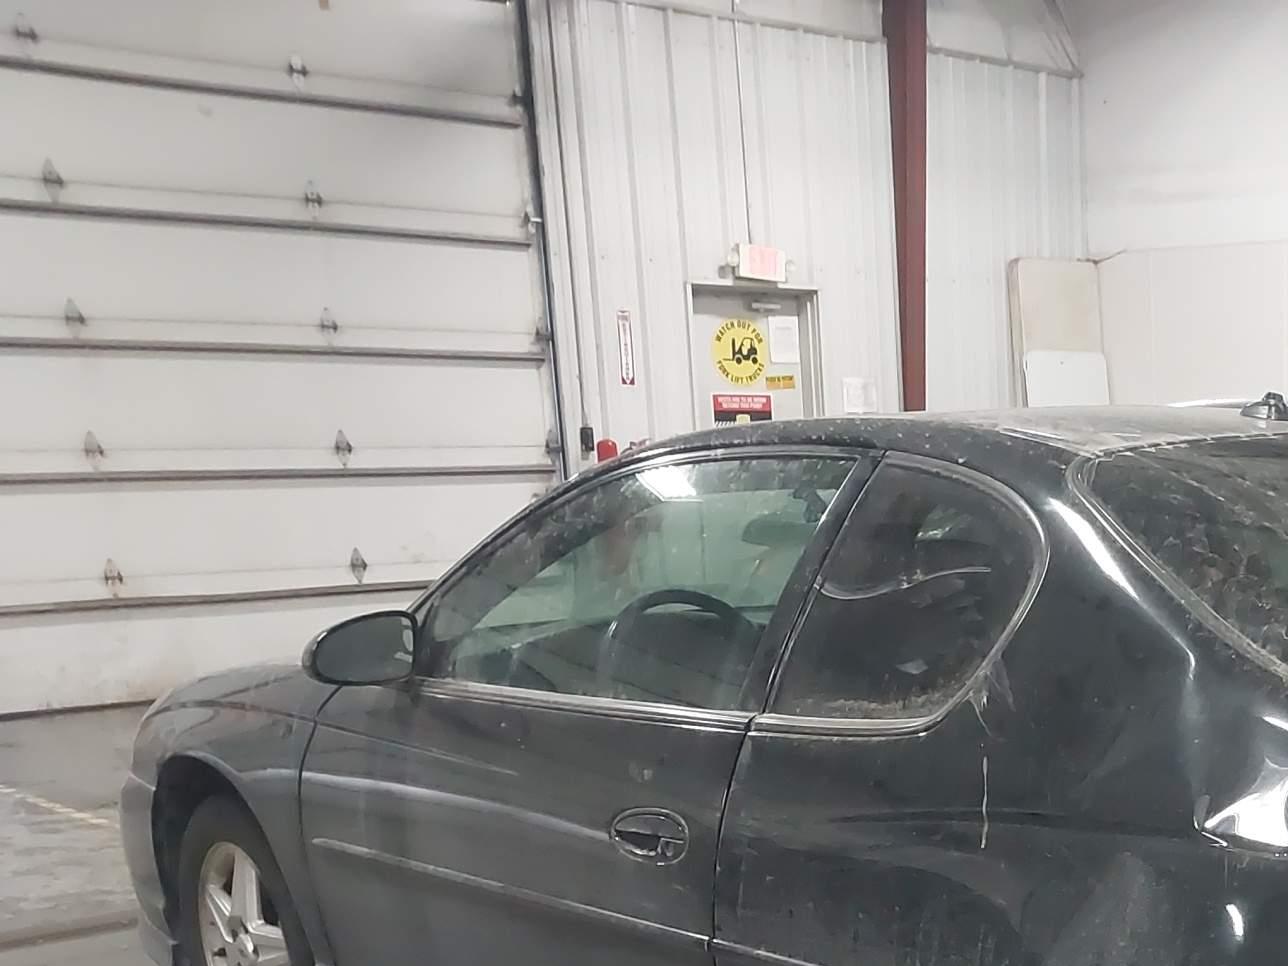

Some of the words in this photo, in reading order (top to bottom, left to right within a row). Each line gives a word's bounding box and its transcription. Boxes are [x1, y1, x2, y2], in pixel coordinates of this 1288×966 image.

[715, 320, 735, 342] WATCH
[737, 319, 751, 331] OUT
[751, 327, 763, 344] FOR
[745, 362, 765, 384] TRUCKS
